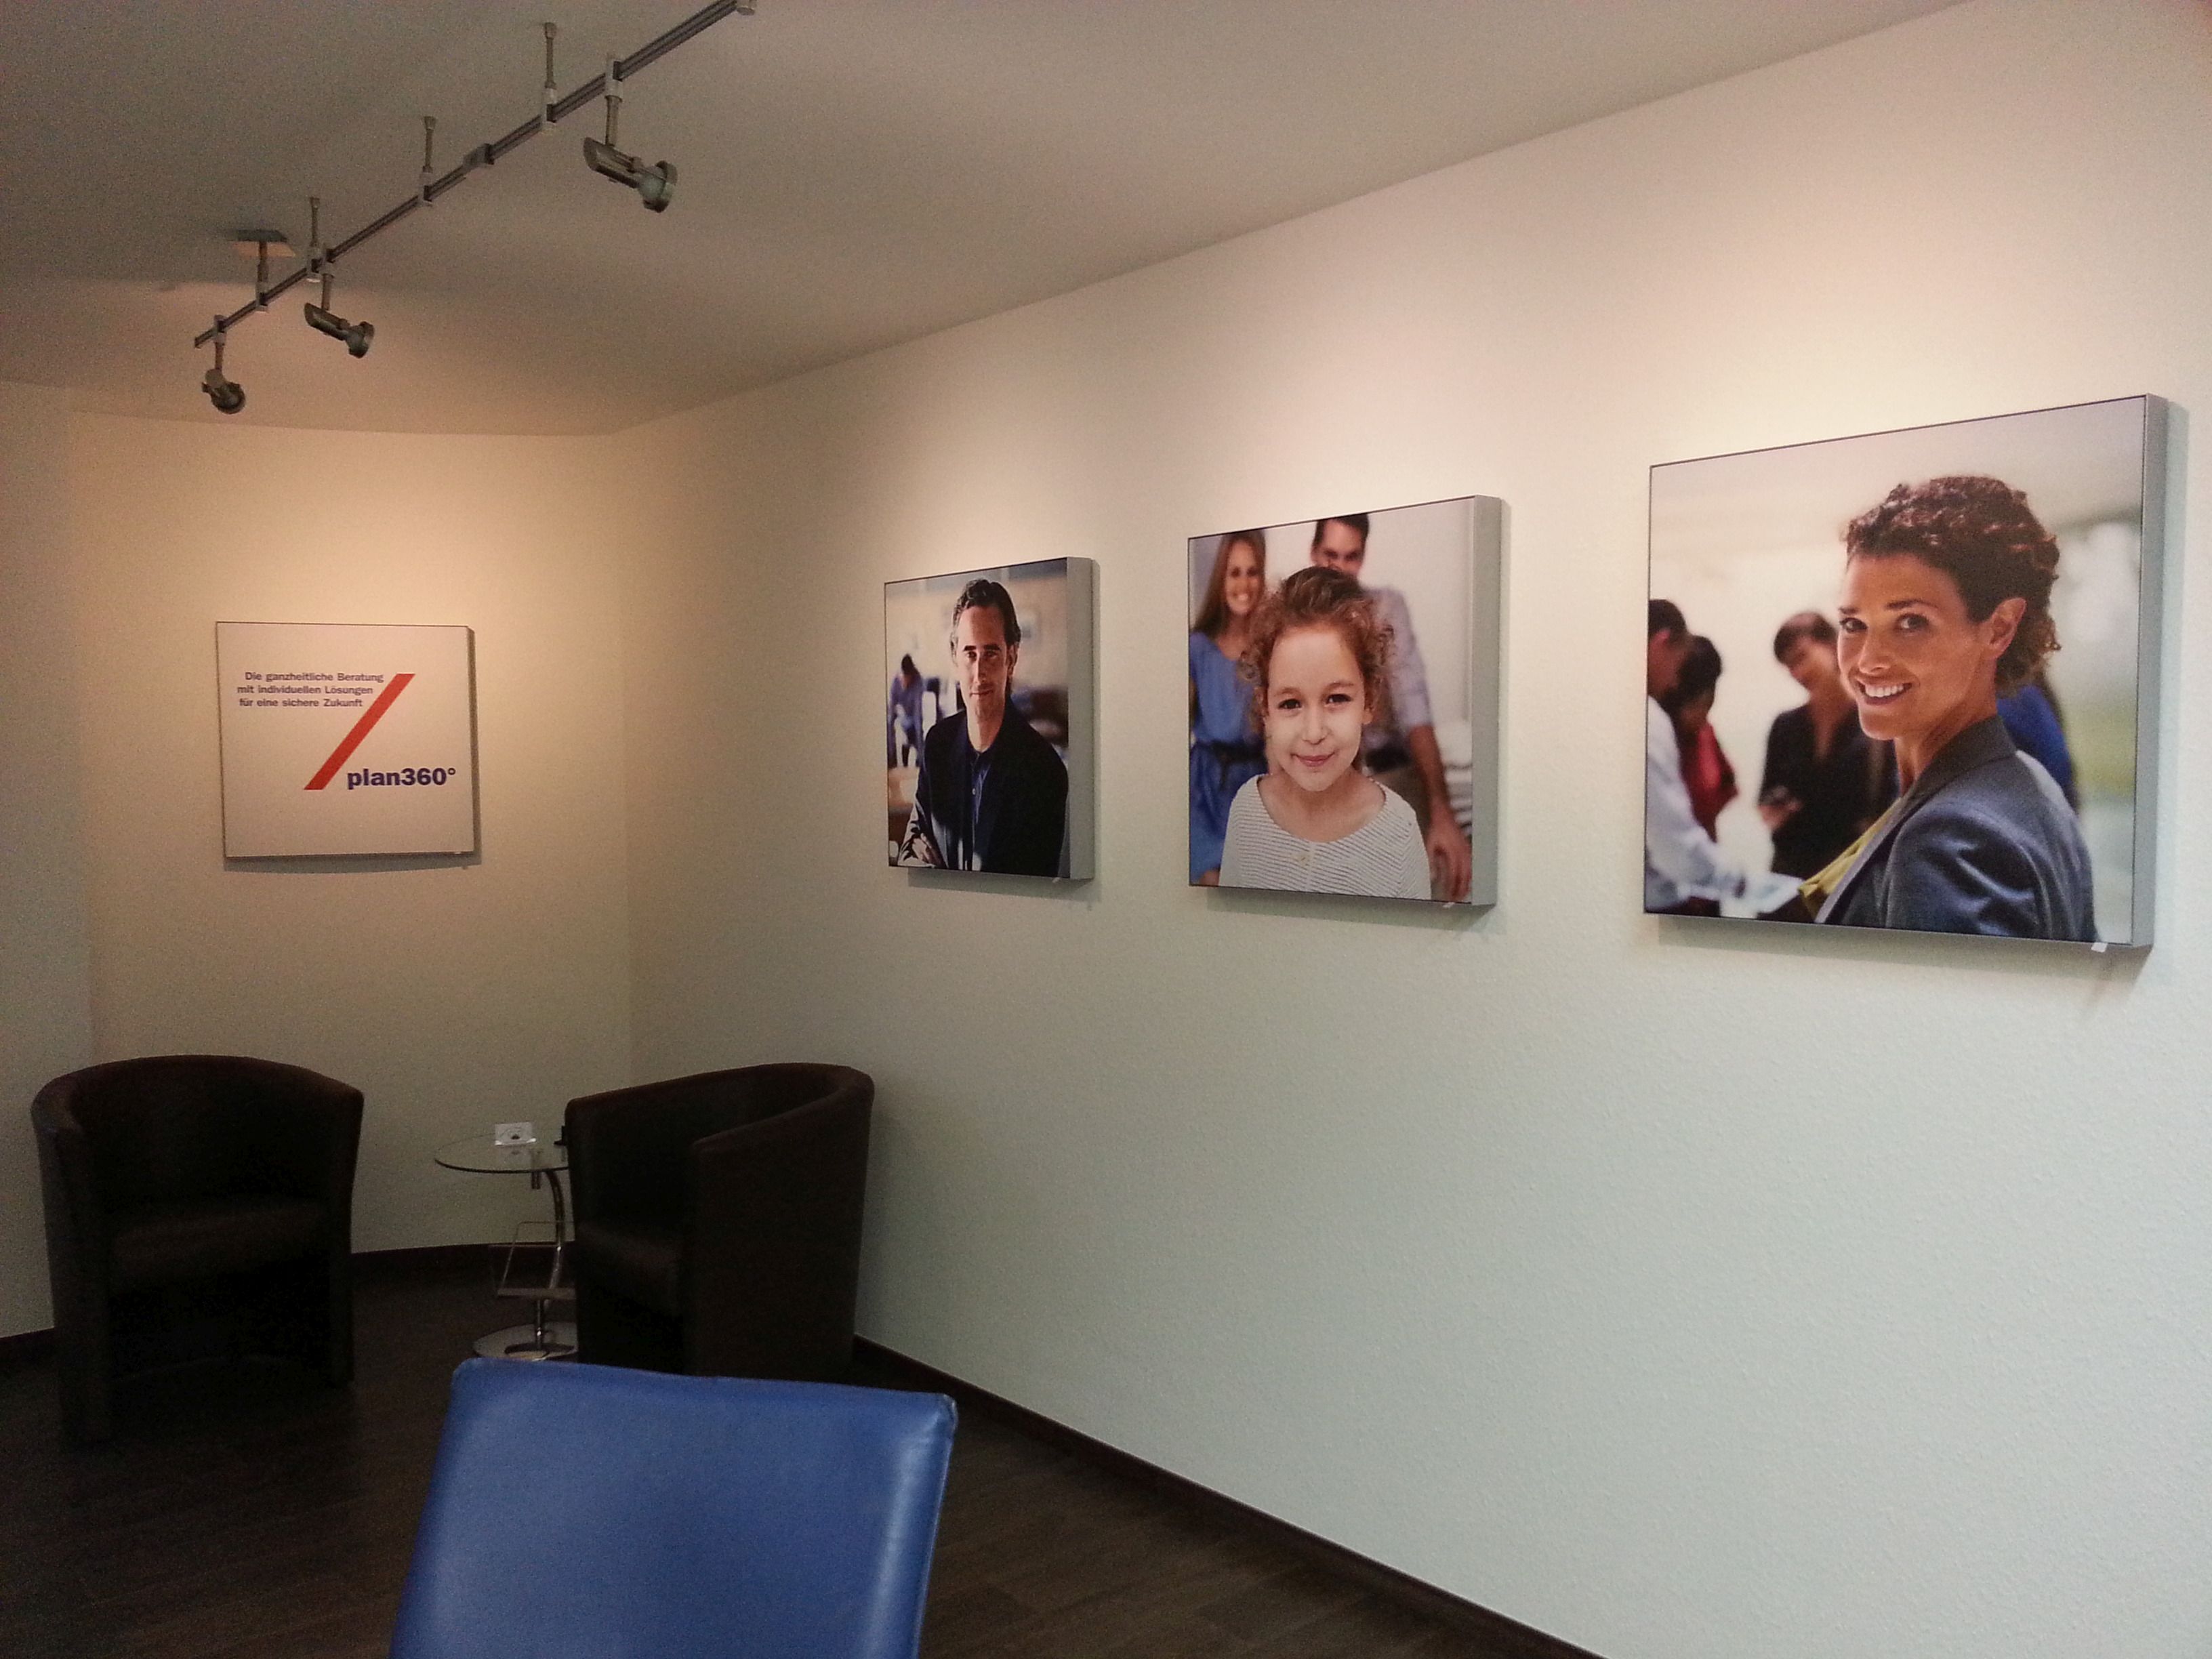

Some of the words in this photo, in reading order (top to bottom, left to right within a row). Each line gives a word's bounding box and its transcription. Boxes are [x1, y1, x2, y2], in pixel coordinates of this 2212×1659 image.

[245, 672, 262, 680] Die
[266, 672, 333, 682] ganzheitliche
[337, 672, 384, 683] Beratung
[237, 684, 254, 693] mit
[258, 684, 321, 694] individuellen
[325, 685, 373, 696] Lösungen
[239, 698, 253, 706] für
[257, 698, 278, 707] eine
[282, 698, 319, 707] sichere
[323, 698, 363, 707] Zukunft
[347, 767, 456, 790] plan360°
